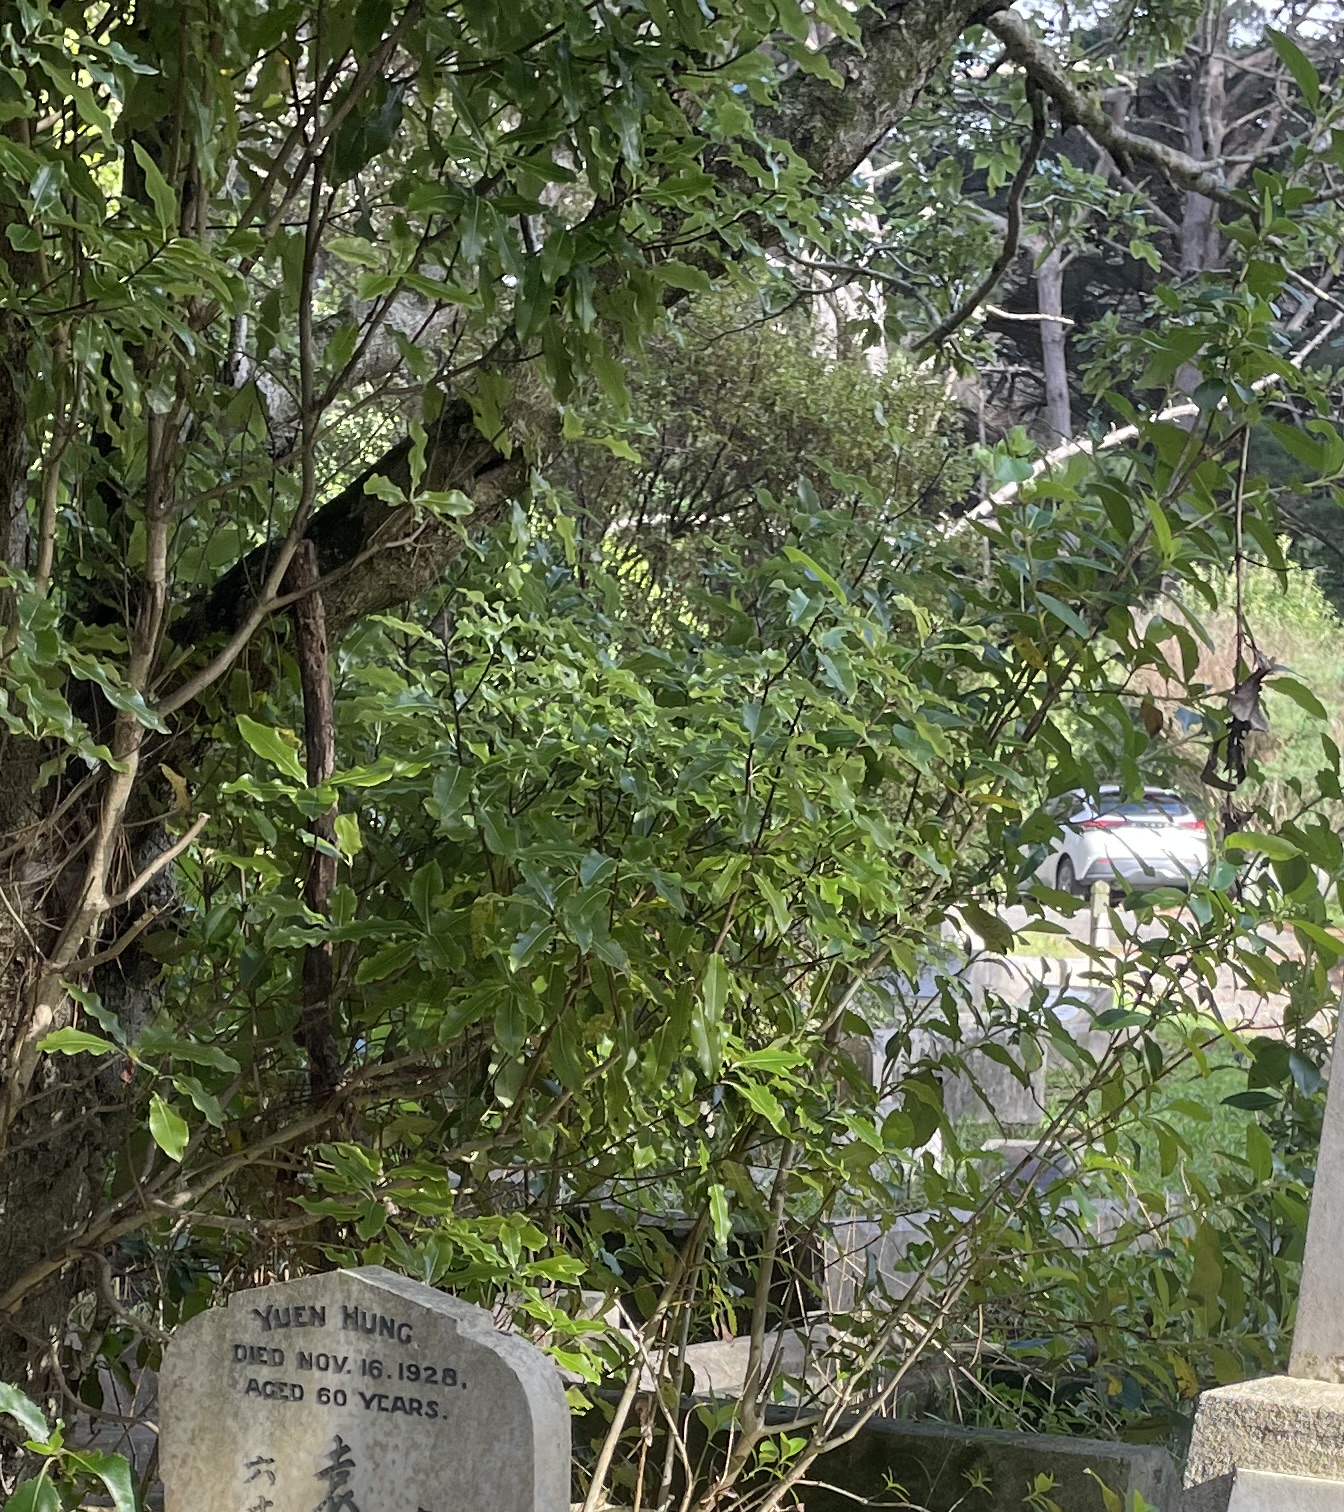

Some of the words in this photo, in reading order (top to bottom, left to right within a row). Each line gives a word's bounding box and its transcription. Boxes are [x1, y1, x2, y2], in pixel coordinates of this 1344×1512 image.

[253, 1303, 326, 1332] YUEN
[341, 1305, 413, 1345] HUNG
[233, 1343, 284, 1367] DIED
[296, 1350, 352, 1375] NOV.
[244, 1378, 304, 1402] AGED
[316, 1387, 348, 1407] 60
[357, 1390, 449, 1420] YEARS.
